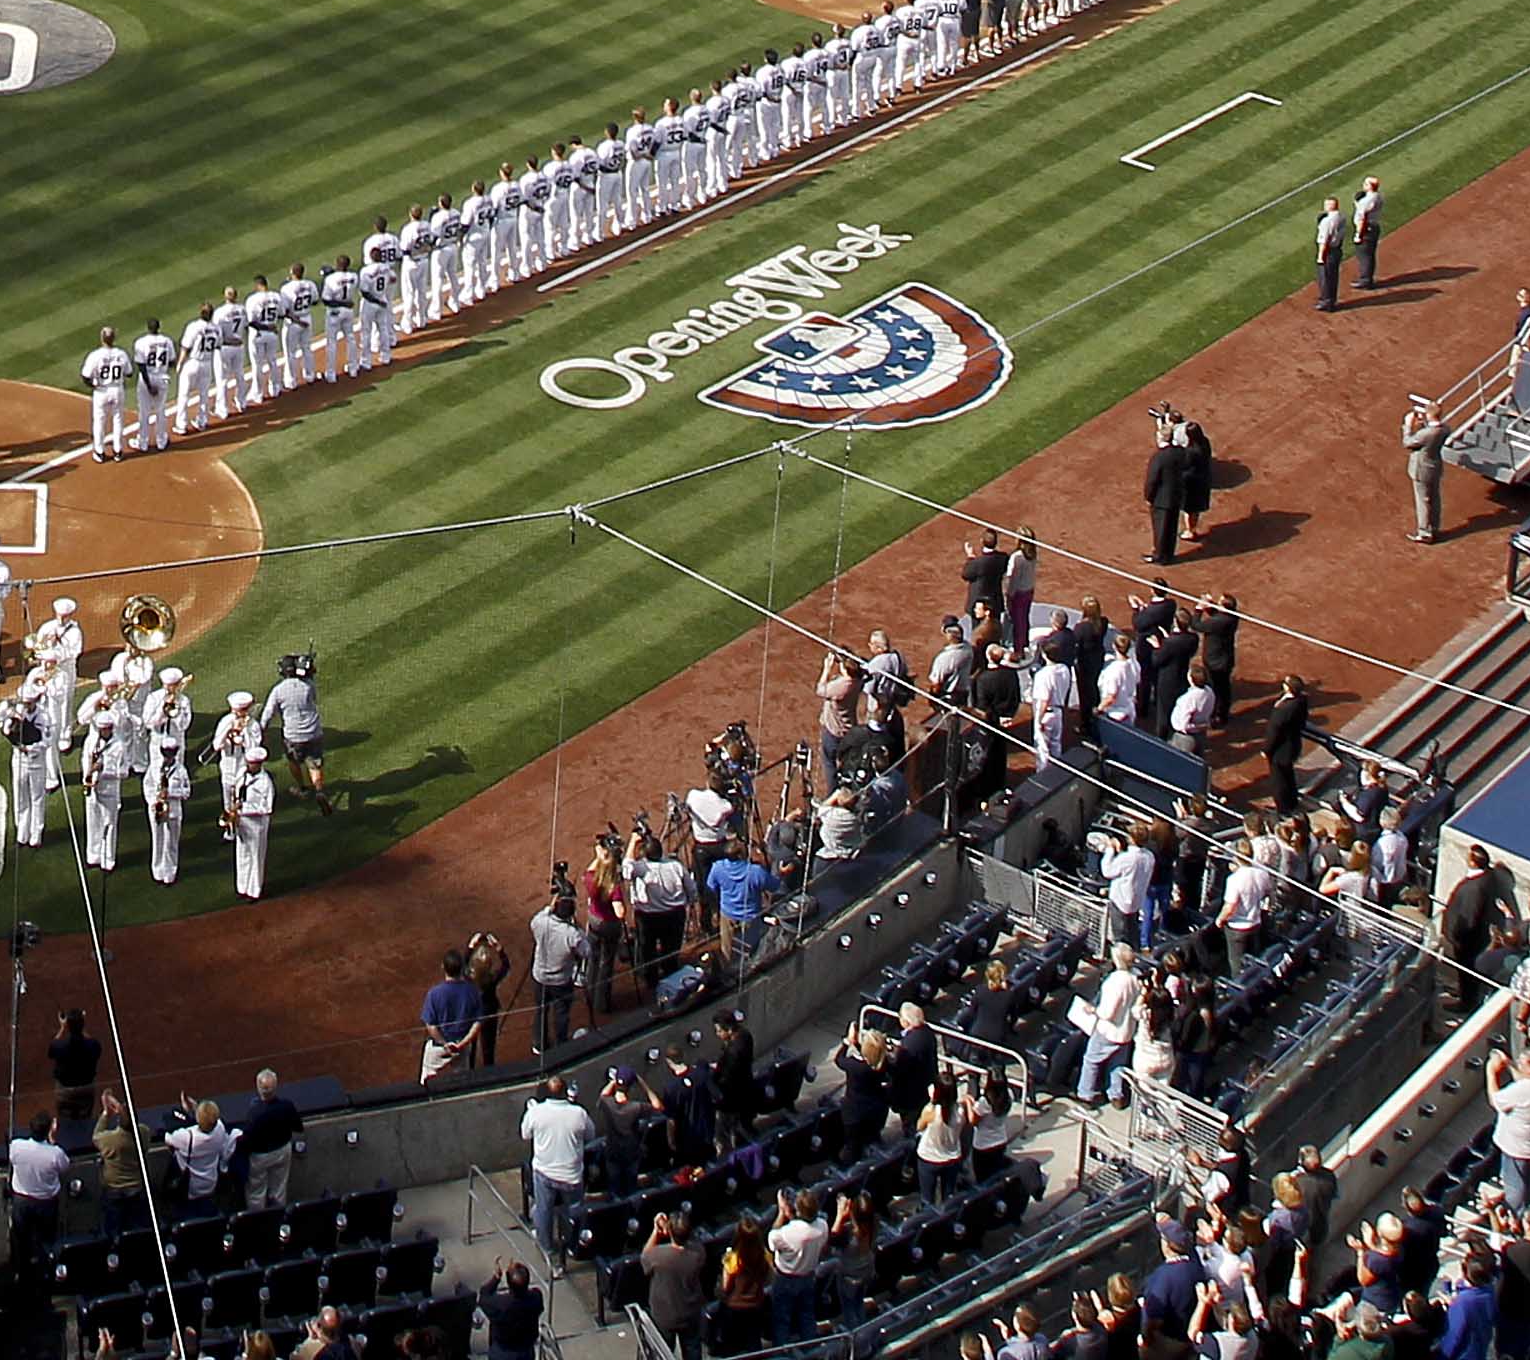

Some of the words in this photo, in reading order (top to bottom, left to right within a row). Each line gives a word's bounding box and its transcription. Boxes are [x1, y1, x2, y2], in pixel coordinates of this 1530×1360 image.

[927, 9, 936, 21] 7
[944, 3, 957, 15] 10
[906, 18, 921, 31] 28
[668, 131, 684, 144] 33
[376, 276, 385, 291] 8
[261, 307, 276, 322] 15
[540, 285, 803, 410] Opening
[725, 222, 913, 299] Week
[232, 318, 241, 333] 7
[200, 337, 215, 352] 13
